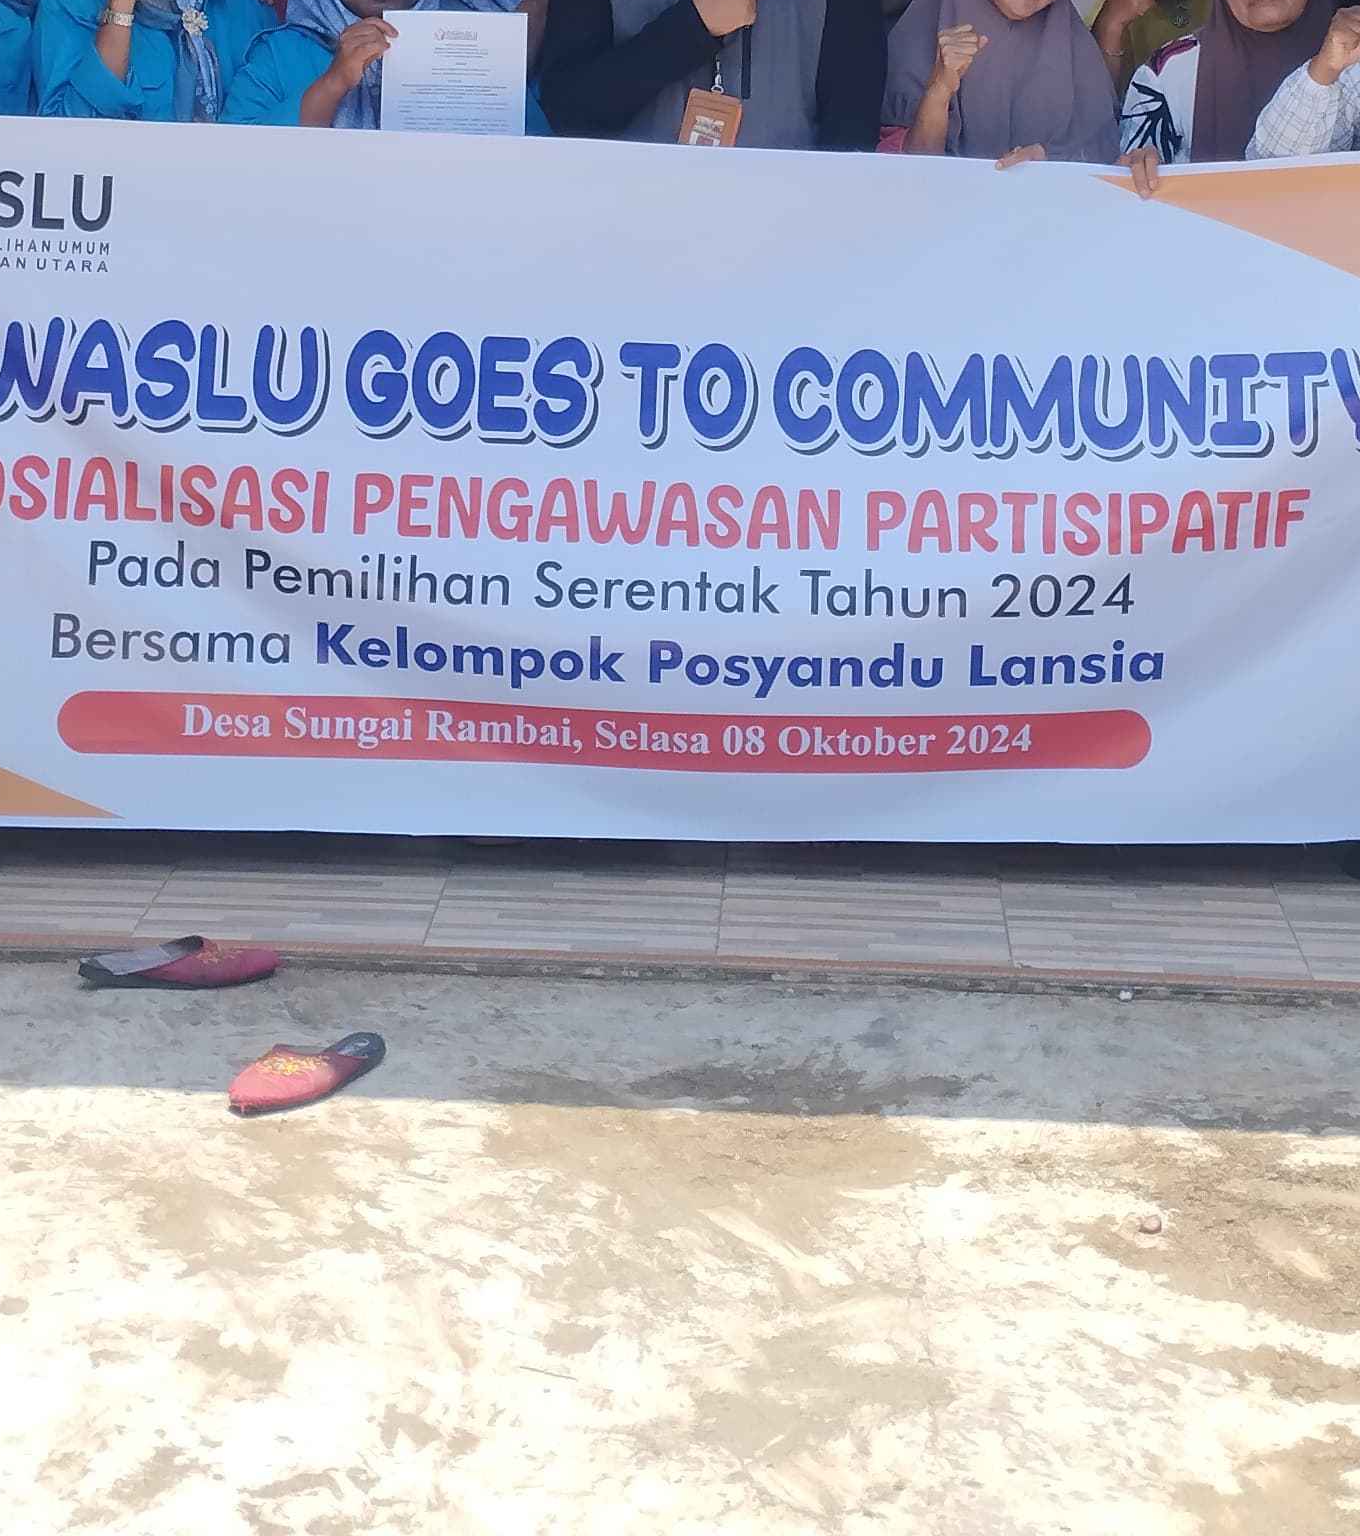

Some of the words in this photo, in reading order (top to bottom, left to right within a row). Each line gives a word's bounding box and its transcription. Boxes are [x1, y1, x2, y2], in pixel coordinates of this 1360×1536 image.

[36, 258, 109, 274] UTARA
[58, 240, 111, 257] UMUM
[345, 329, 603, 449] GOES
[619, 342, 758, 454] TO
[352, 472, 841, 551] PENGAWASAN
[866, 488, 1311, 556] PARTISIPATIF
[88, 540, 221, 588] Pada
[244, 549, 511, 606] Pemilihan
[534, 560, 781, 616] Serentak
[799, 569, 967, 618] Tahun
[990, 572, 1136, 620] 2024
[51, 613, 291, 664] Bersama
[316, 623, 626, 690] Kelompok
[649, 640, 944, 699] Posyandu
[968, 640, 1164, 687] Lansia
[181, 703, 271, 739] Desa
[283, 707, 413, 751] Sungai
[425, 711, 583, 753] Rambai,
[594, 716, 711, 755] Selasa
[721, 722, 767, 755] 08
[778, 725, 937, 757] Oktober
[946, 723, 1033, 754] 2024
